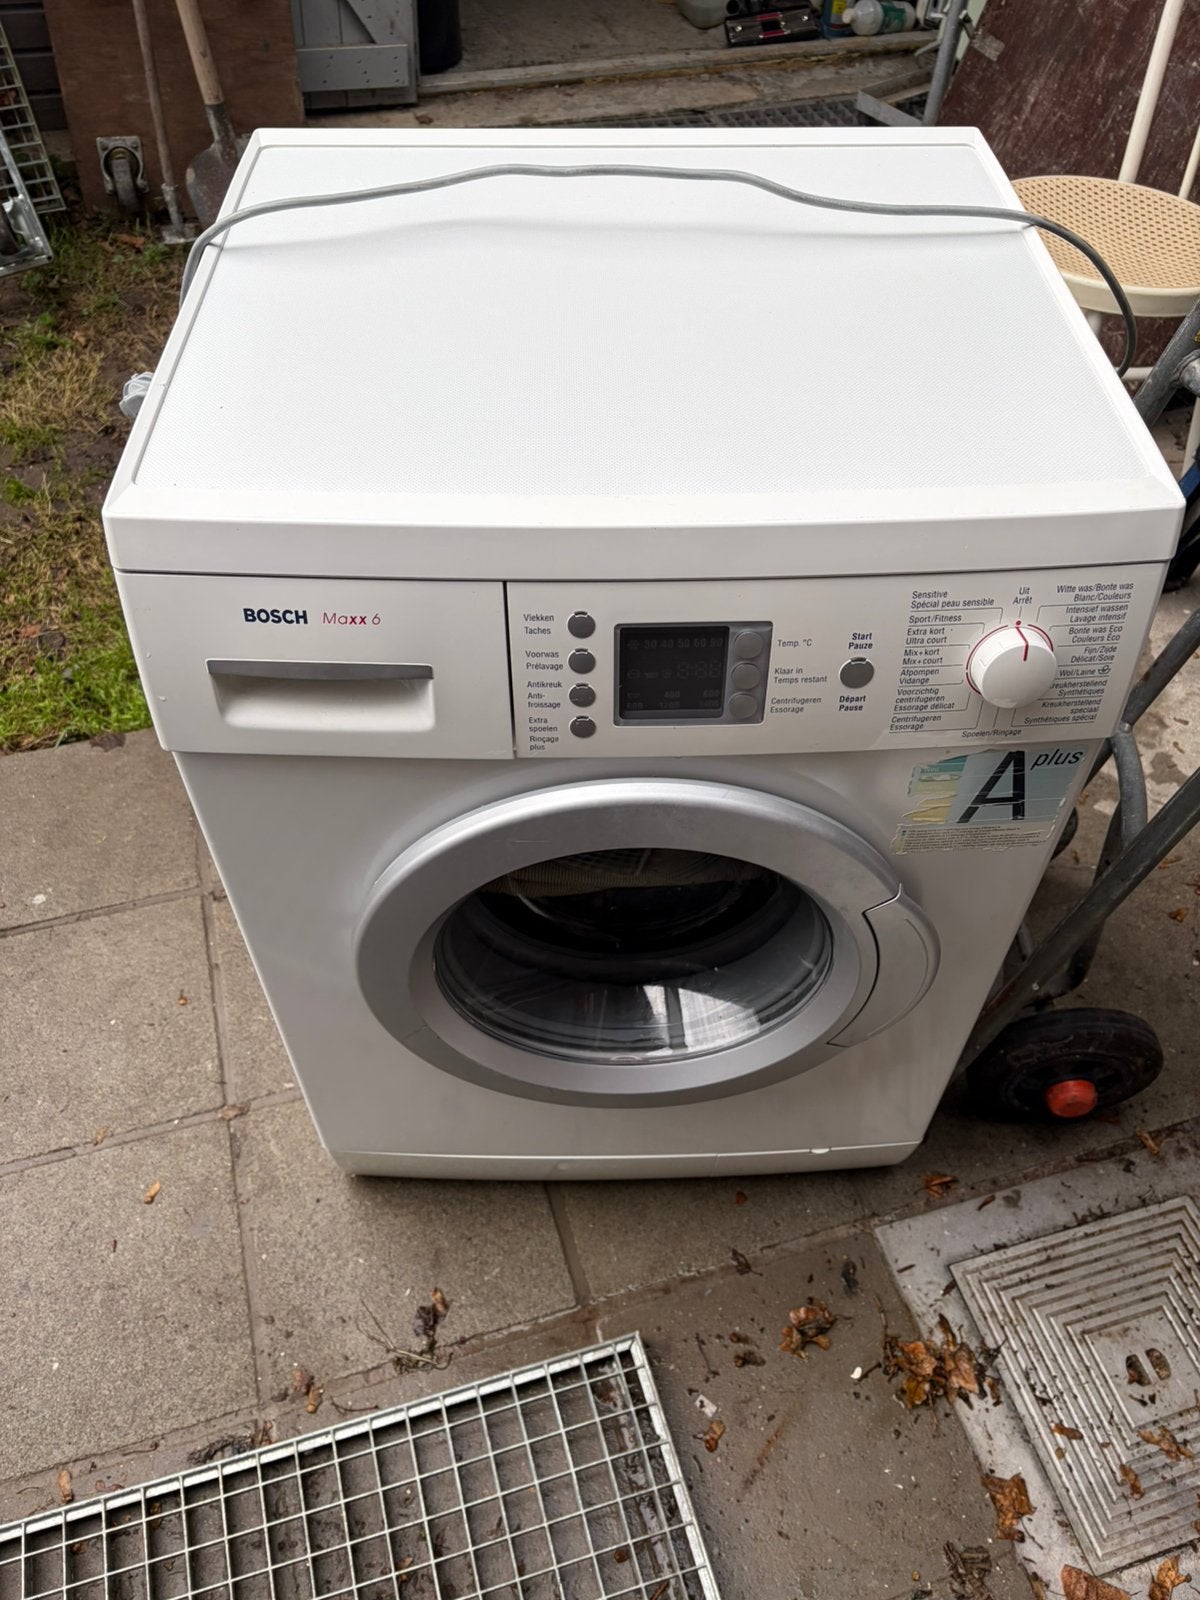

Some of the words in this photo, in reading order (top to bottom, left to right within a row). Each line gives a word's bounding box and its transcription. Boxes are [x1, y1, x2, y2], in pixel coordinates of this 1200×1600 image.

[1019, 587, 1030, 595] Uit
[1056, 584, 1076, 593] Witte
[1078, 583, 1117, 592] was/Bonte
[912, 591, 948, 599] Sensitive
[1074, 592, 1132, 602] Blanc/Couleurs
[911, 600, 940, 609] Spécial
[942, 601, 961, 609] peau
[962, 598, 995, 607] sensible
[1012, 596, 1032, 605] Arrêt
[1066, 606, 1099, 614] Intensief
[243, 608, 308, 625] BOSCH
[323, 612, 367, 625] Maxx
[372, 613, 381, 626] 6
[909, 615, 962, 624] Sport/Fitness
[1070, 615, 1096, 624] Lavage
[1098, 613, 1126, 621] intensif
[524, 626, 552, 635] Taches
[907, 628, 928, 636] Extra
[929, 627, 945, 635] kort
[1068, 626, 1090, 635] Bonte
[1093, 626, 1107, 634] was
[1109, 625, 1123, 633] Eco
[777, 640, 800, 648] Temp.
[803, 639, 812, 647] °C
[905, 637, 925, 645] Ultra
[927, 636, 947, 644] court
[1072, 635, 1105, 644] Couleurs
[848, 642, 873, 650] Pauze
[1070, 654, 1115, 664] Délicat/Soie
[526, 662, 564, 671] Prélavage
[900, 668, 940, 677] Afpompen
[1059, 669, 1096, 677] Wol/Laine
[774, 677, 799, 685] Temps
[899, 677, 930, 686] Vidange
[1050, 680, 1108, 689] reukherstellend
[528, 692, 546, 700] Anti-
[897, 688, 939, 696] Voorzichtig
[771, 697, 822, 705] Centrifugeren
[839, 695, 866, 704] Départ
[895, 695, 945, 703] centrifugeren
[528, 701, 561, 709] froissage
[839, 704, 863, 712] Pause
[894, 704, 928, 712] Essorage
[931, 702, 955, 710] délicat
[770, 706, 804, 714] Essorage
[891, 714, 942, 723] Centrifugeren
[890, 724, 924, 732] Essorage
[529, 735, 559, 744] Rinçage
[956, 750, 1025, 824] A
[1031, 749, 1084, 770] plus
